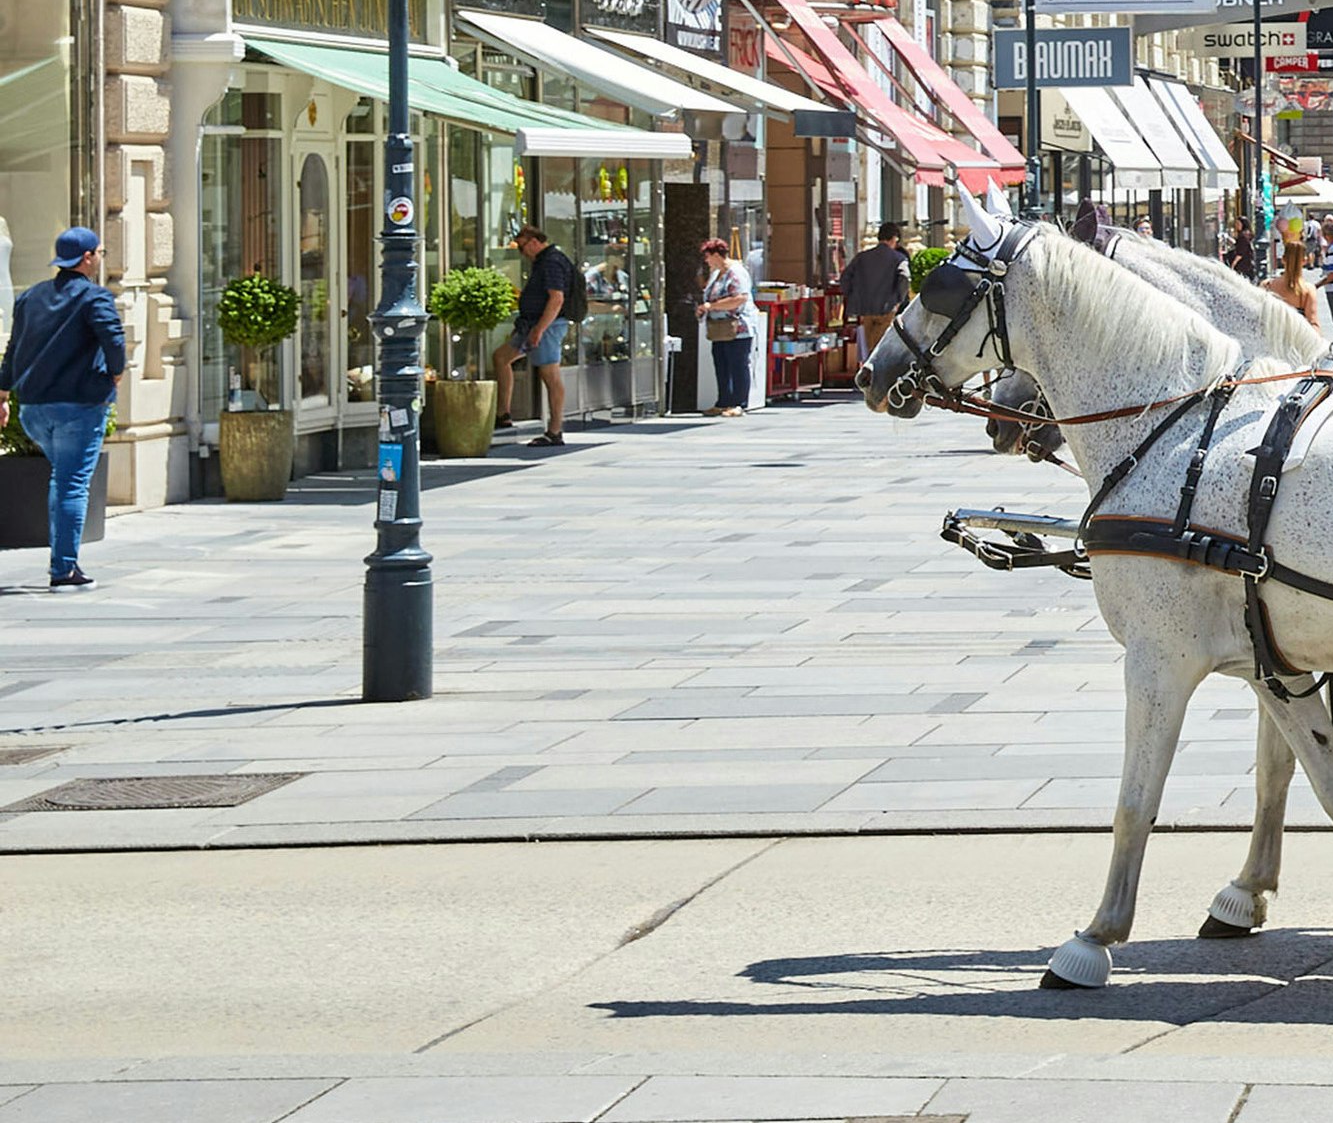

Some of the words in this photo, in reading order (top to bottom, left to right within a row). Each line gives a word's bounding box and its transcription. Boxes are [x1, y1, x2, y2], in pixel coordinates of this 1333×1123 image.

[1204, 31, 1281, 48] swatch
[1013, 40, 1113, 79] BAUMAX
[1274, 58, 1309, 70] CAMPER
